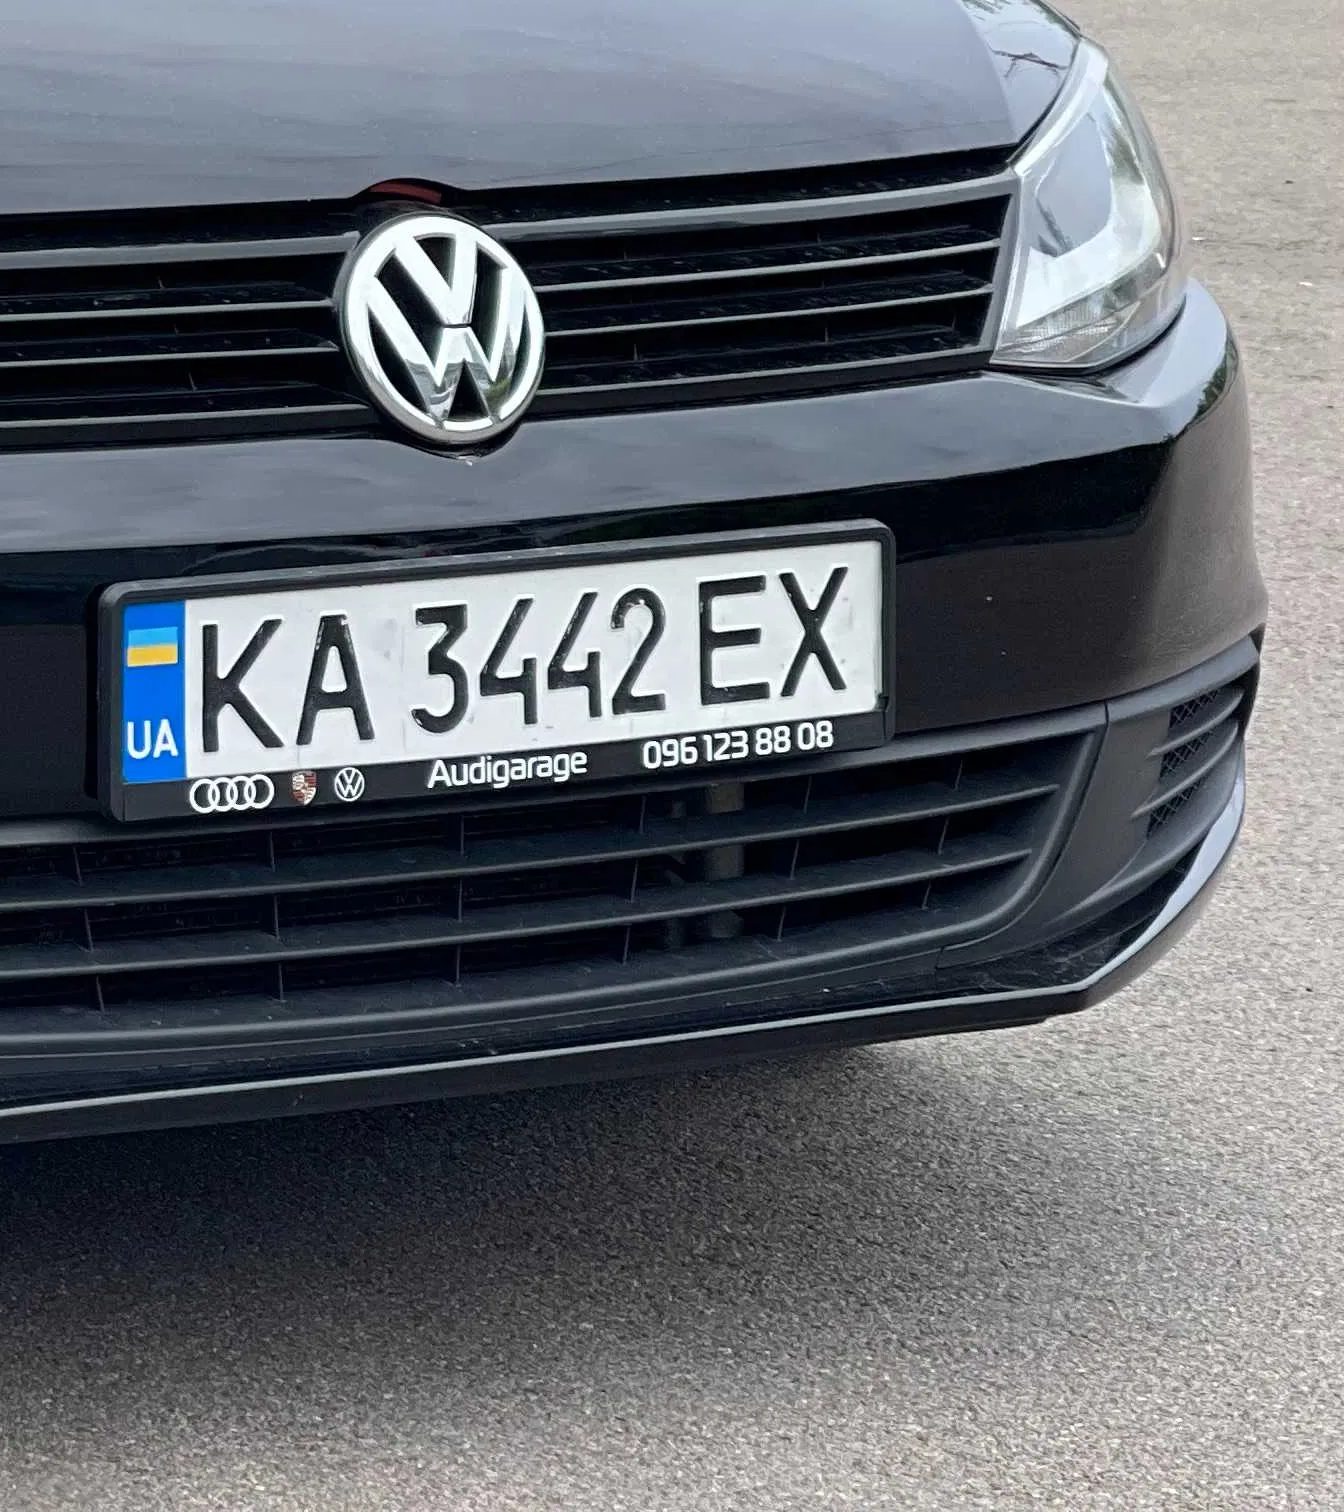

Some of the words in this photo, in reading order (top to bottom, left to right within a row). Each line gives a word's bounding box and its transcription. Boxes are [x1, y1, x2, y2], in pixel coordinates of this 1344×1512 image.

[344, 214, 545, 443] VW
[201, 613, 376, 753] KA
[410, 586, 668, 735] 3442
[698, 565, 849, 707] EX
[126, 718, 179, 760] UA
[642, 735, 699, 770] 096
[702, 729, 749, 762] 123
[754, 724, 791, 756] 88
[796, 719, 835, 751] 08
[333, 766, 365, 803] VW
[427, 750, 588, 790] Audigarage
